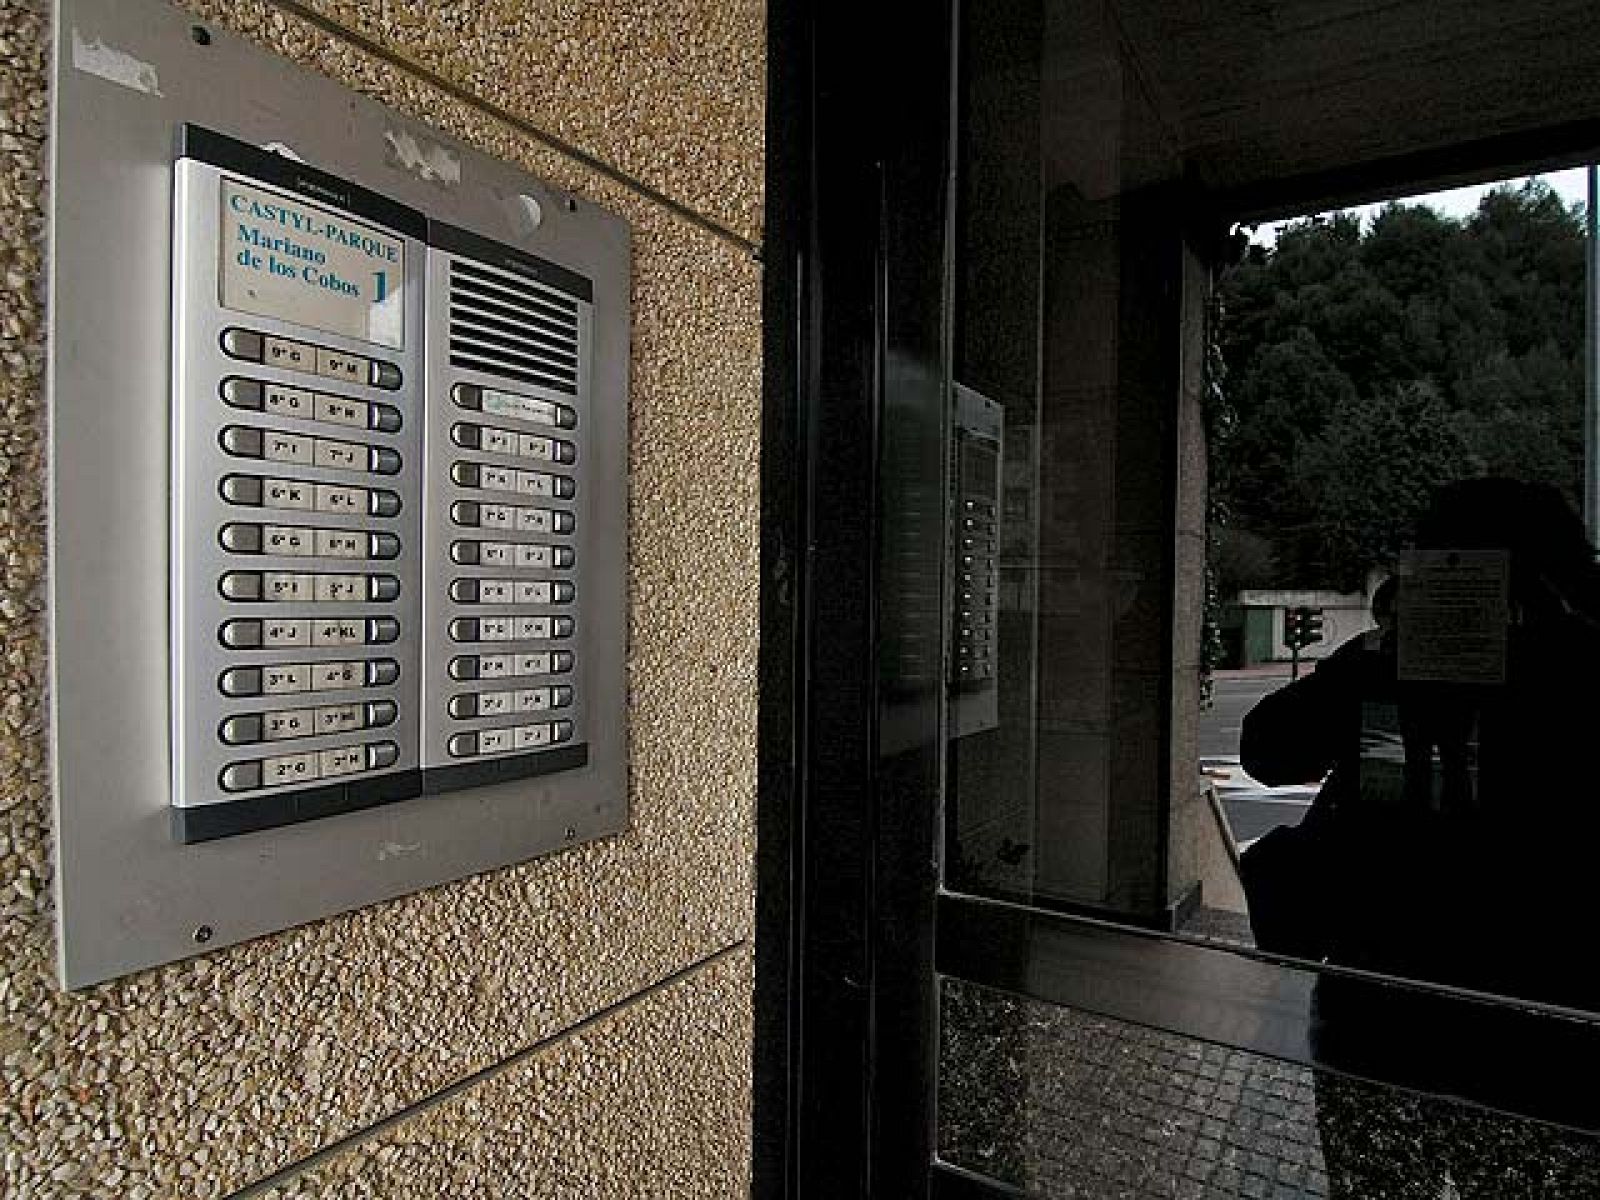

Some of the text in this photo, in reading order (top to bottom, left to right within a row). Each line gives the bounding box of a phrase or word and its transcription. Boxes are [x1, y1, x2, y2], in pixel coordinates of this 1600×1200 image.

[229, 193, 399, 263] CASTYL-PARQUE
[237, 224, 326, 265] Mariano
[237, 249, 360, 298] de los Cobos
[371, 270, 386, 303] 1
